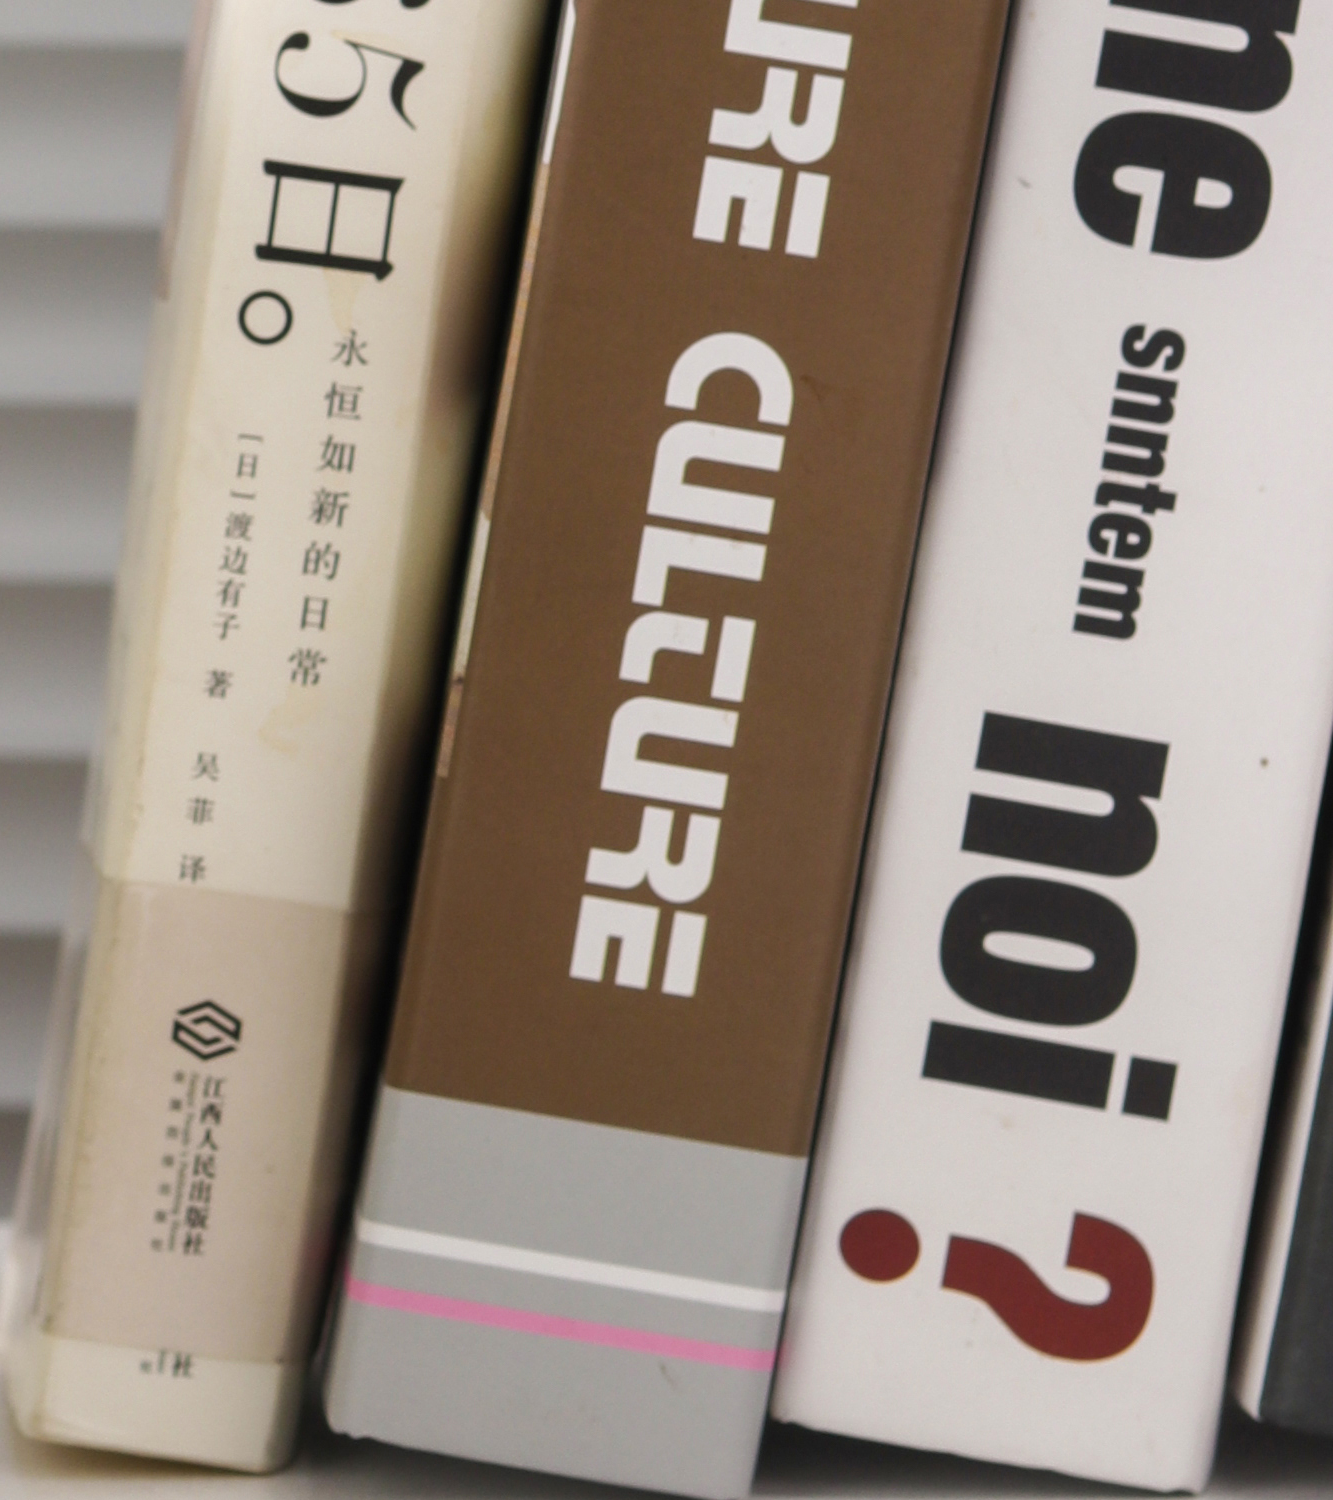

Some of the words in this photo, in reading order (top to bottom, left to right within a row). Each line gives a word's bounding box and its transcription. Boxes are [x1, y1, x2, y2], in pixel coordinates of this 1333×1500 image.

[288, 329, 369, 688] 永恒如新的日常
[569, 331, 794, 998] CULTURE
[921, 710, 1178, 1122] noi
